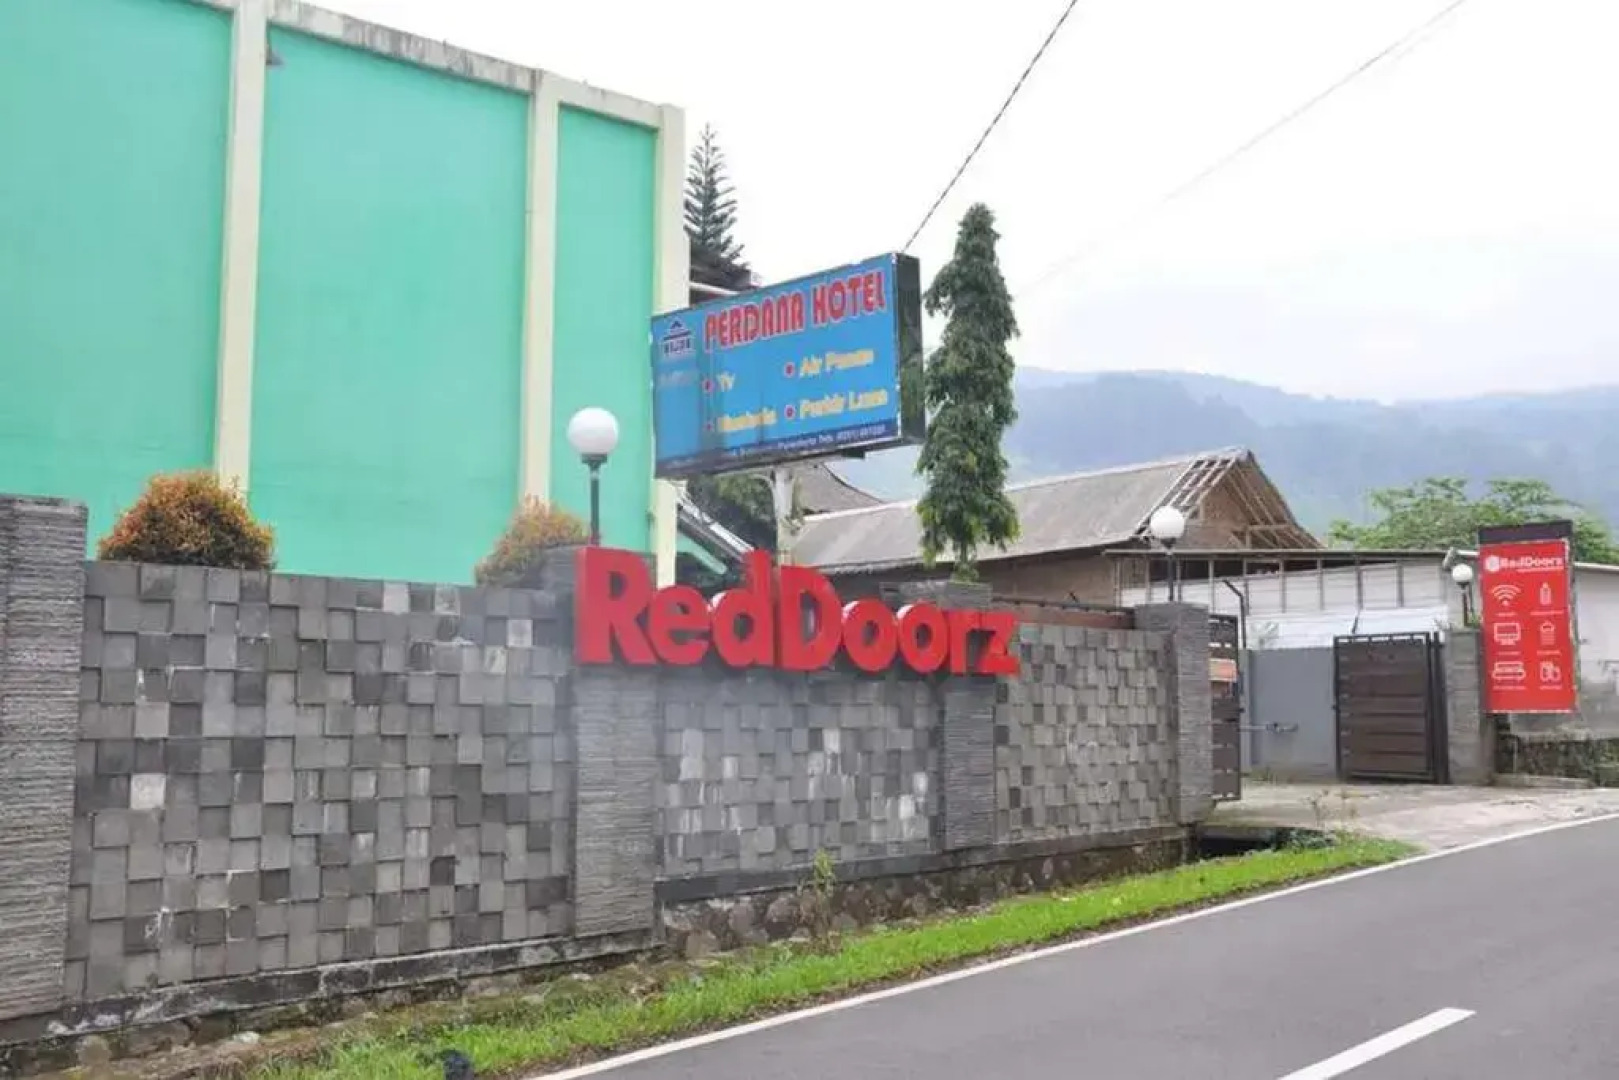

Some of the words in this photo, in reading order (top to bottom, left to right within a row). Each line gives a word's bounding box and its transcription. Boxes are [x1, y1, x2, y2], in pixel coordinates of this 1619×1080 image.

[704, 291, 804, 352] PERDANA
[812, 271, 886, 325] HOTEL
[574, 545, 1020, 676] RedDoorz
